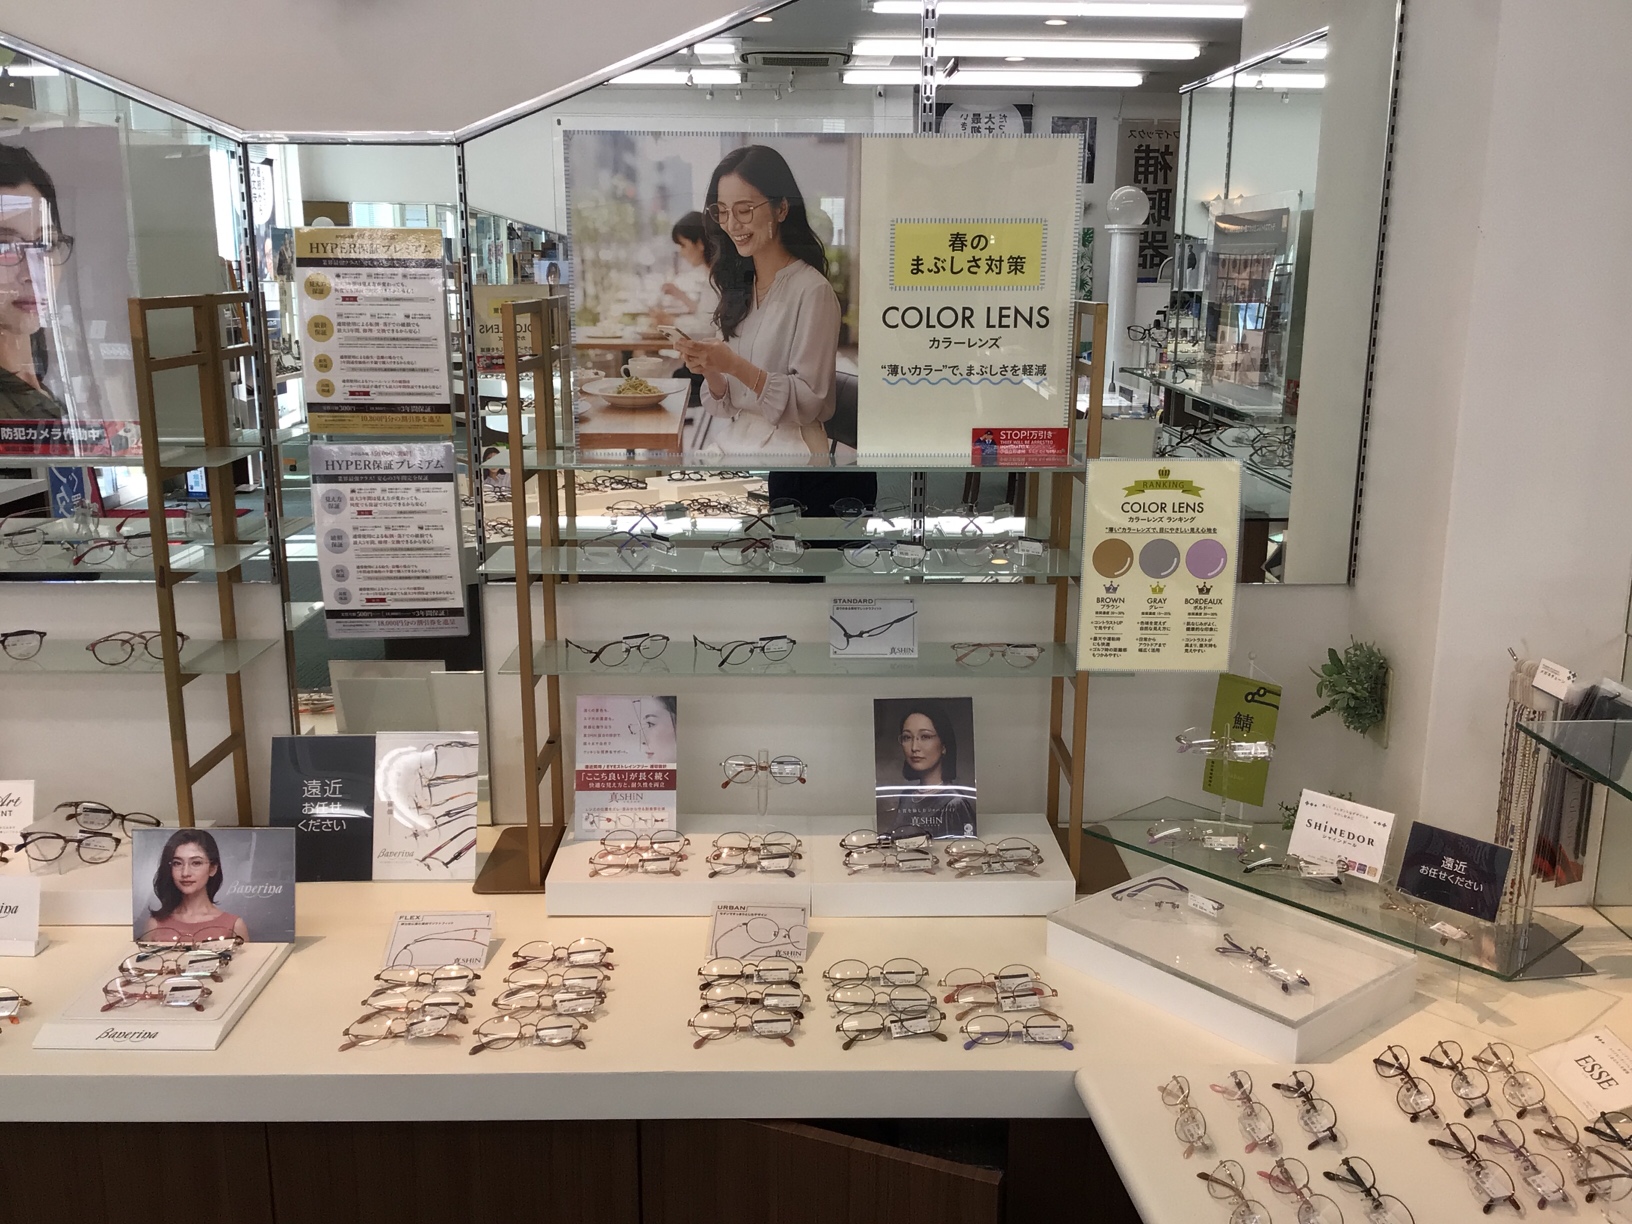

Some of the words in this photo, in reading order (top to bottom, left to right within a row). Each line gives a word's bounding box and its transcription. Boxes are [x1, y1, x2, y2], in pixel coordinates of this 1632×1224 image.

[948, 232, 989, 252] 春の
[910, 255, 1026, 276] まぶしさ対策
[882, 306, 975, 329] COLOR
[986, 306, 1050, 329] LENS
[929, 336, 1002, 350] カラーレンズ
[1, 427, 100, 440] 防犯カメラ作動中
[1000, 430, 1053, 440] STOP!万引き
[325, 460, 444, 470] HYPER保証プレミアム
[1142, 481, 1185, 489] RANKING
[1121, 502, 1167, 514] COLOR
[1172, 502, 1205, 514] LENS
[582, 772, 670, 780] 「ここち良い」が長く続く
[302, 779, 343, 798] 遠近
[301, 802, 342, 814] お任せ
[297, 820, 346, 832] ください
[1322, 834, 1357, 847] シャインドール
[1440, 855, 1468, 874] 遠近
[1419, 864, 1483, 891] お任せください
[226, 880, 283, 899] Banerina
[95, 1027, 159, 1042] Banerina
[1574, 1054, 1619, 1090] ESSE
